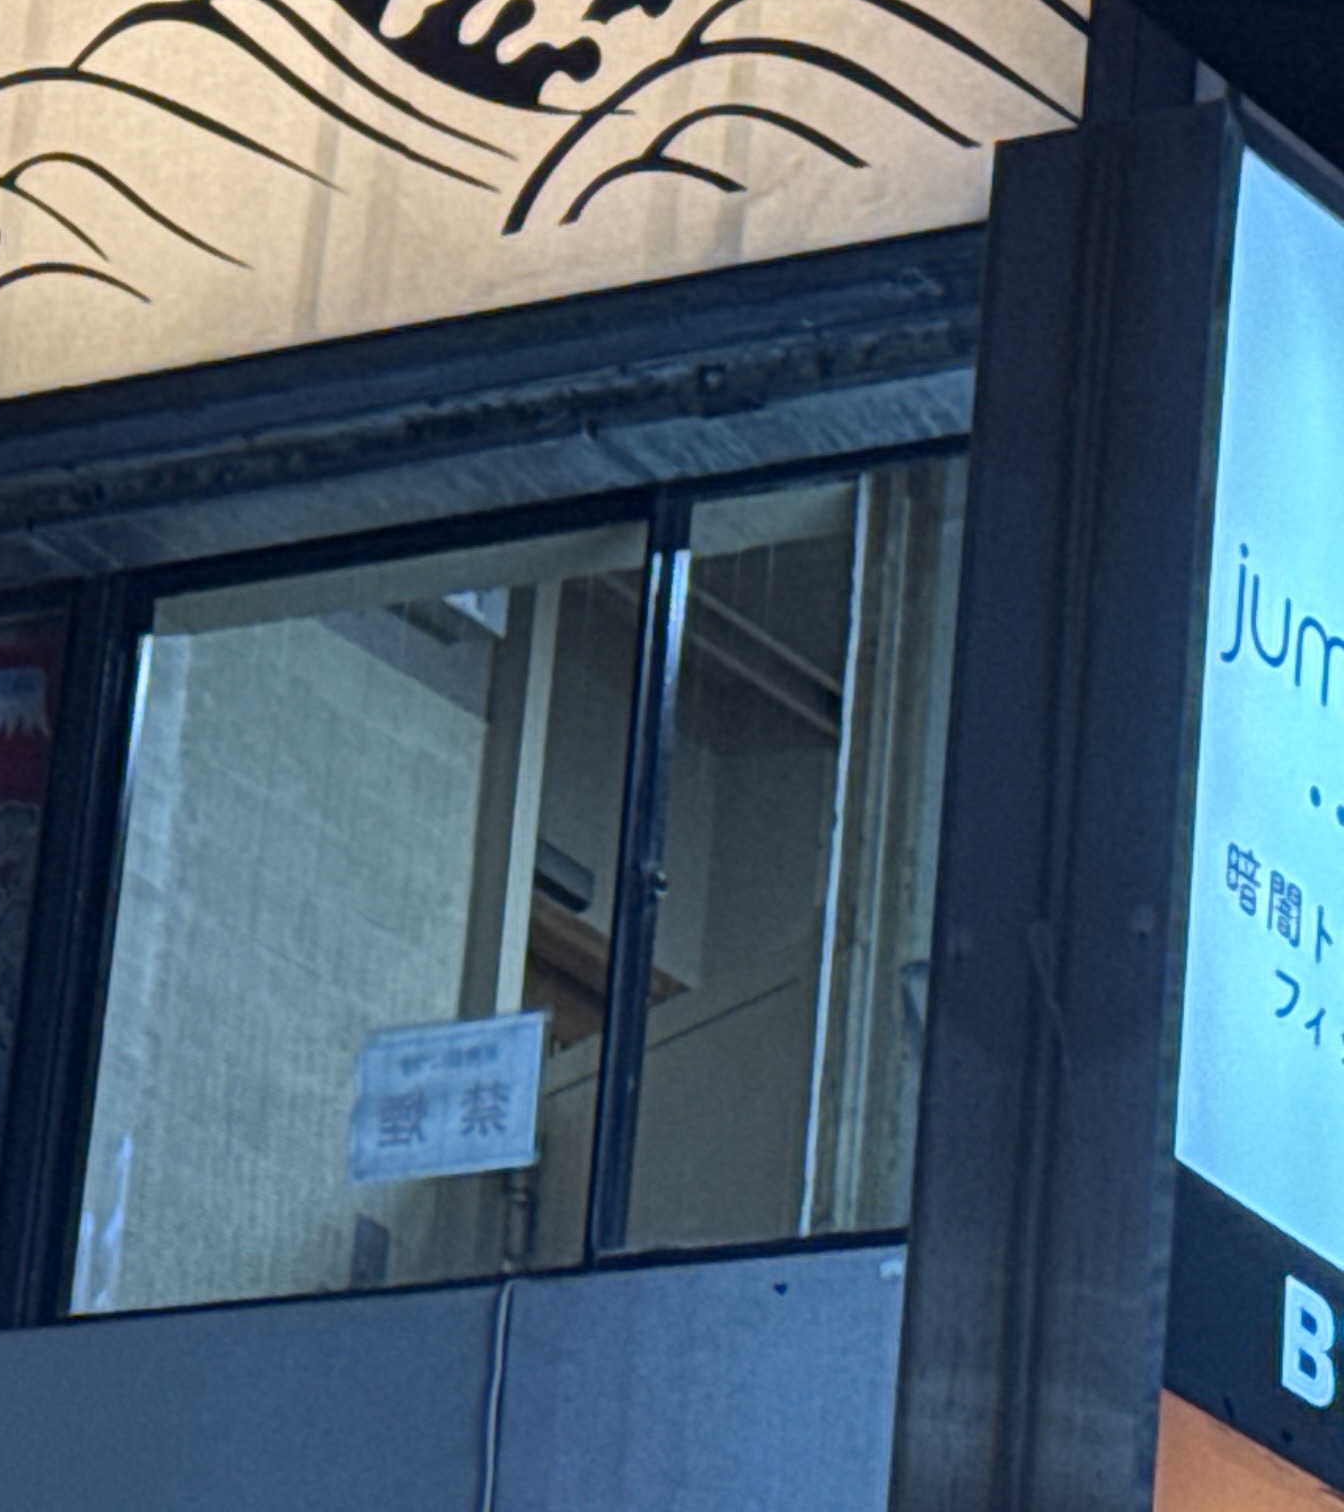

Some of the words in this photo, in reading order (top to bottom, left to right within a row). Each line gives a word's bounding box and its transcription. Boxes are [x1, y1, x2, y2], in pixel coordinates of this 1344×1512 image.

[1225, 841, 1334, 965] 暗闇ト
[1274, 968, 1344, 1066] フィ
[1280, 1274, 1344, 1409] B
